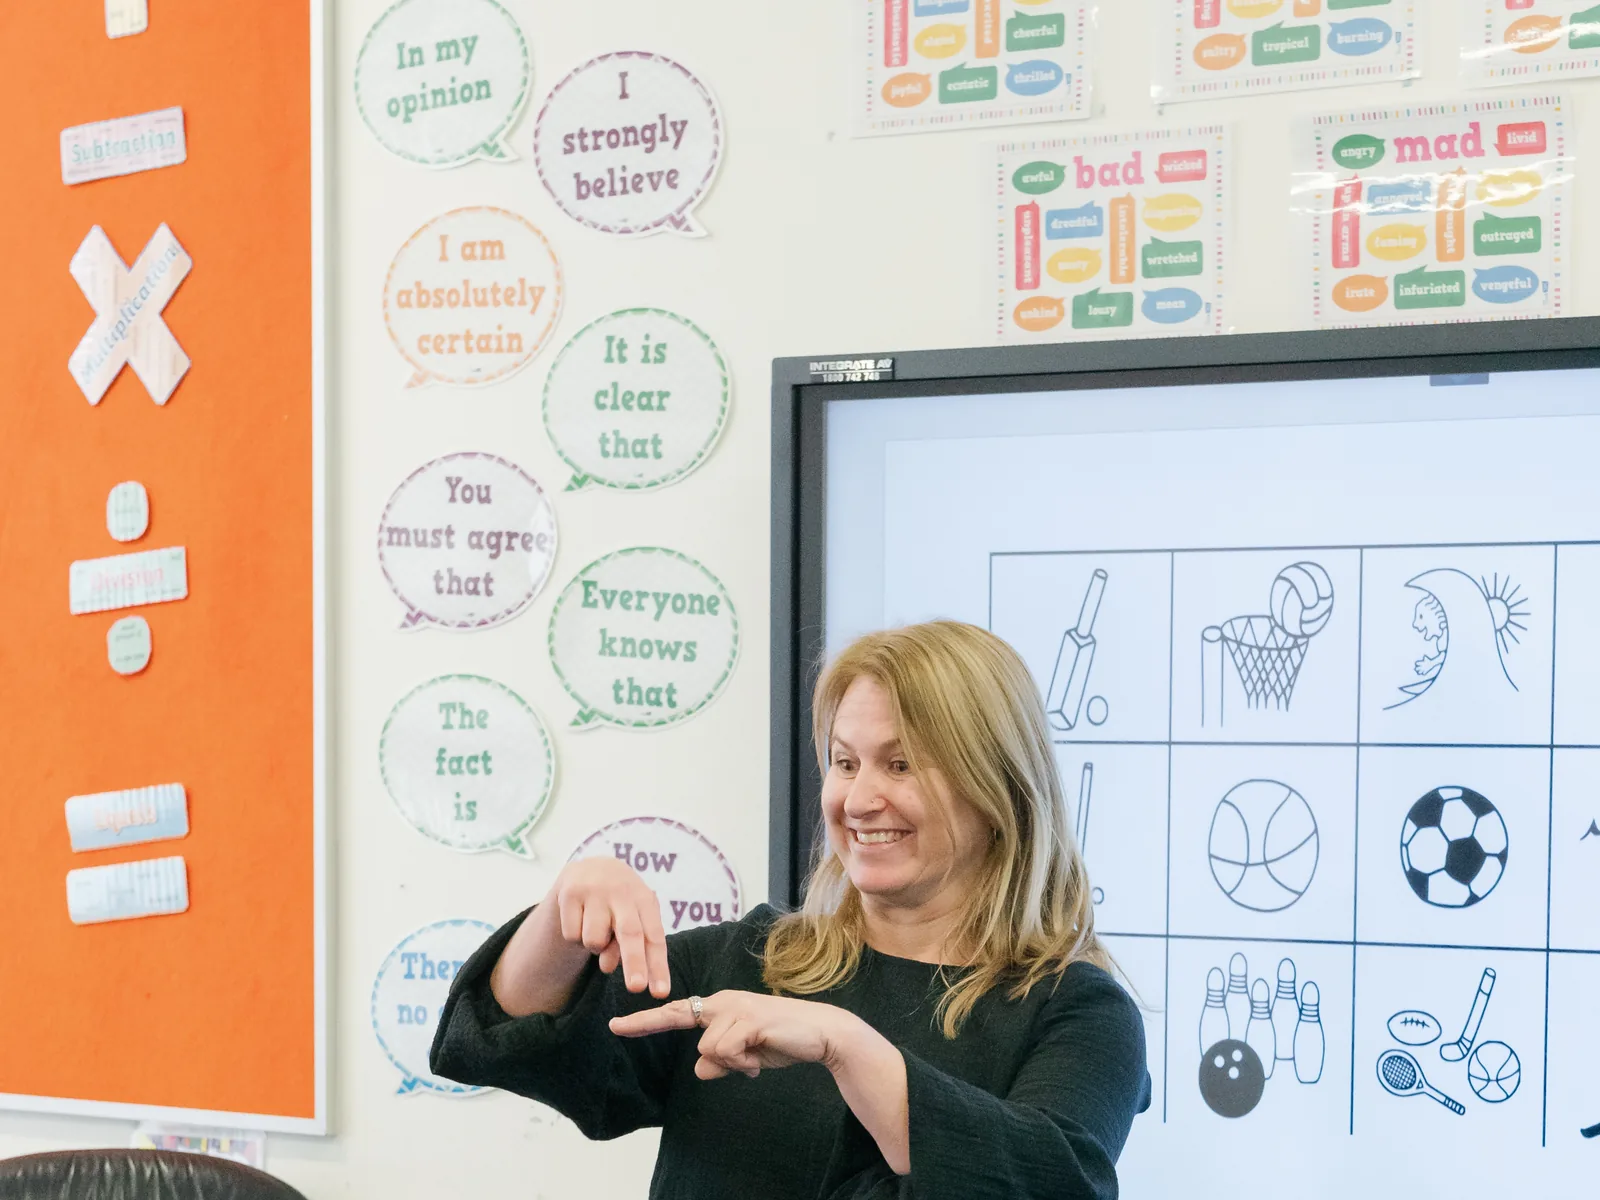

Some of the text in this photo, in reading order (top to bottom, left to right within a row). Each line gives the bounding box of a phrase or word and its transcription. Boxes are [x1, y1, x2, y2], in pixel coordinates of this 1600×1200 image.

[1013, 24, 1057, 38] cheerful
[1263, 37, 1309, 53] tropical
[1337, 30, 1384, 45] burning
[397, 35, 478, 69] In my
[619, 72, 629, 99] I
[1014, 71, 1056, 84] thrilled
[388, 76, 492, 123] opinion
[71, 130, 176, 164] Subtraction
[563, 113, 688, 154] strongly
[1393, 122, 1485, 163] mad
[1507, 130, 1537, 145] livid
[1341, 147, 1375, 159] angry
[573, 165, 679, 200] believe
[1022, 170, 1054, 183] awful
[1073, 151, 1144, 189] bad
[1051, 215, 1098, 229] dreadful
[1481, 228, 1534, 243] outraged
[439, 235, 505, 262] I am
[1022, 211, 1033, 283] unpleasant
[1147, 252, 1198, 265] wretched
[397, 277, 546, 315] absolutely
[1346, 288, 1375, 298] irate
[1400, 282, 1460, 296] infuriated
[1480, 278, 1532, 293] vengeful
[80, 241, 183, 385] Multiplication
[418, 324, 523, 354] certain
[604, 334, 667, 364] It is
[809, 358, 892, 371] INTEGRATE AV
[595, 382, 671, 411] clear
[599, 430, 663, 460] that
[445, 477, 492, 504] You
[387, 524, 549, 559] must agree
[434, 568, 494, 597] that
[581, 580, 721, 621] Everyone
[599, 628, 697, 662] knows
[612, 677, 677, 709] that
[439, 702, 488, 730] The
[436, 748, 492, 775] fact
[455, 792, 477, 821] is
[614, 843, 677, 872] How
[670, 900, 722, 929] you
[401, 952, 465, 980] Ther
[398, 1004, 427, 1025] no
